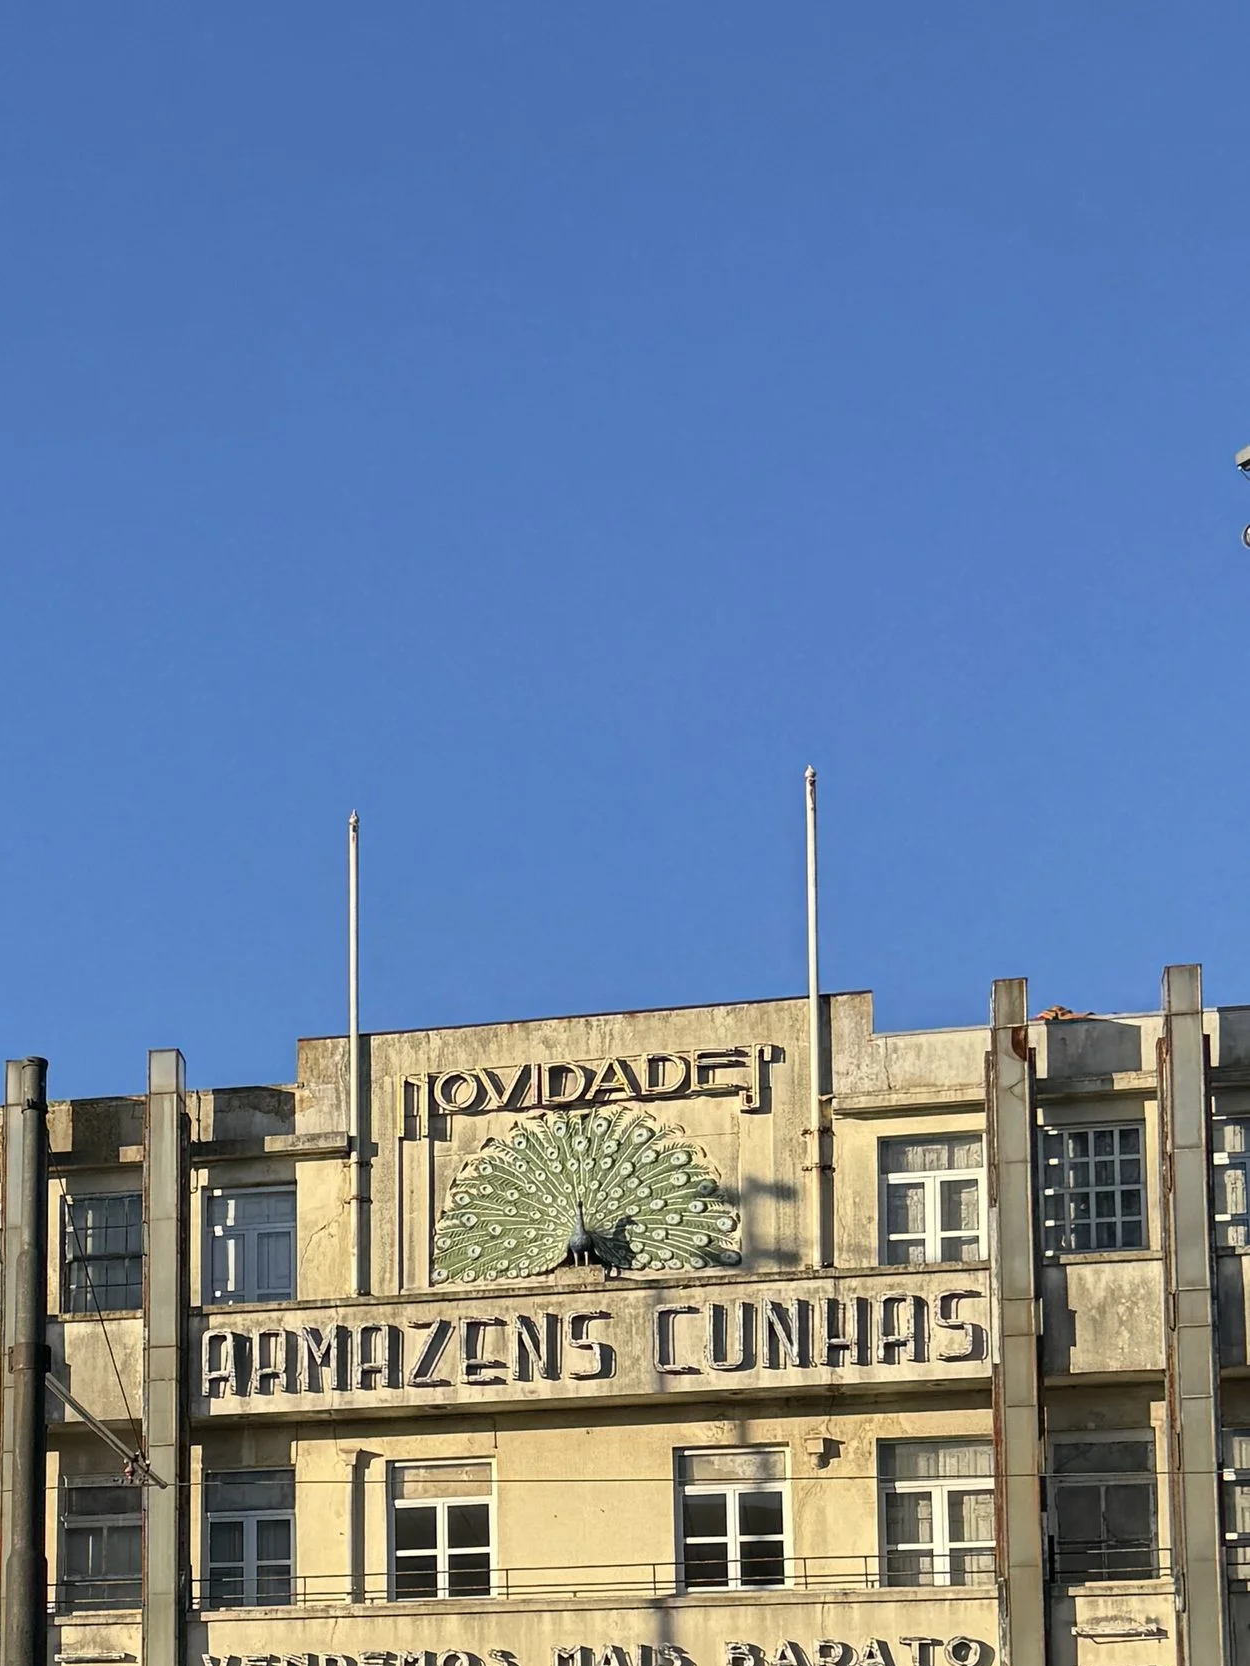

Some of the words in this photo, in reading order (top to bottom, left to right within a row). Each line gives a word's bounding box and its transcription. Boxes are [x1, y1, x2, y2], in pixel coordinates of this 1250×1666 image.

[398, 1043, 774, 1138] NOVIDADES
[201, 1308, 617, 1398] ARMAZENS
[653, 1289, 988, 1375] CUNHAS
